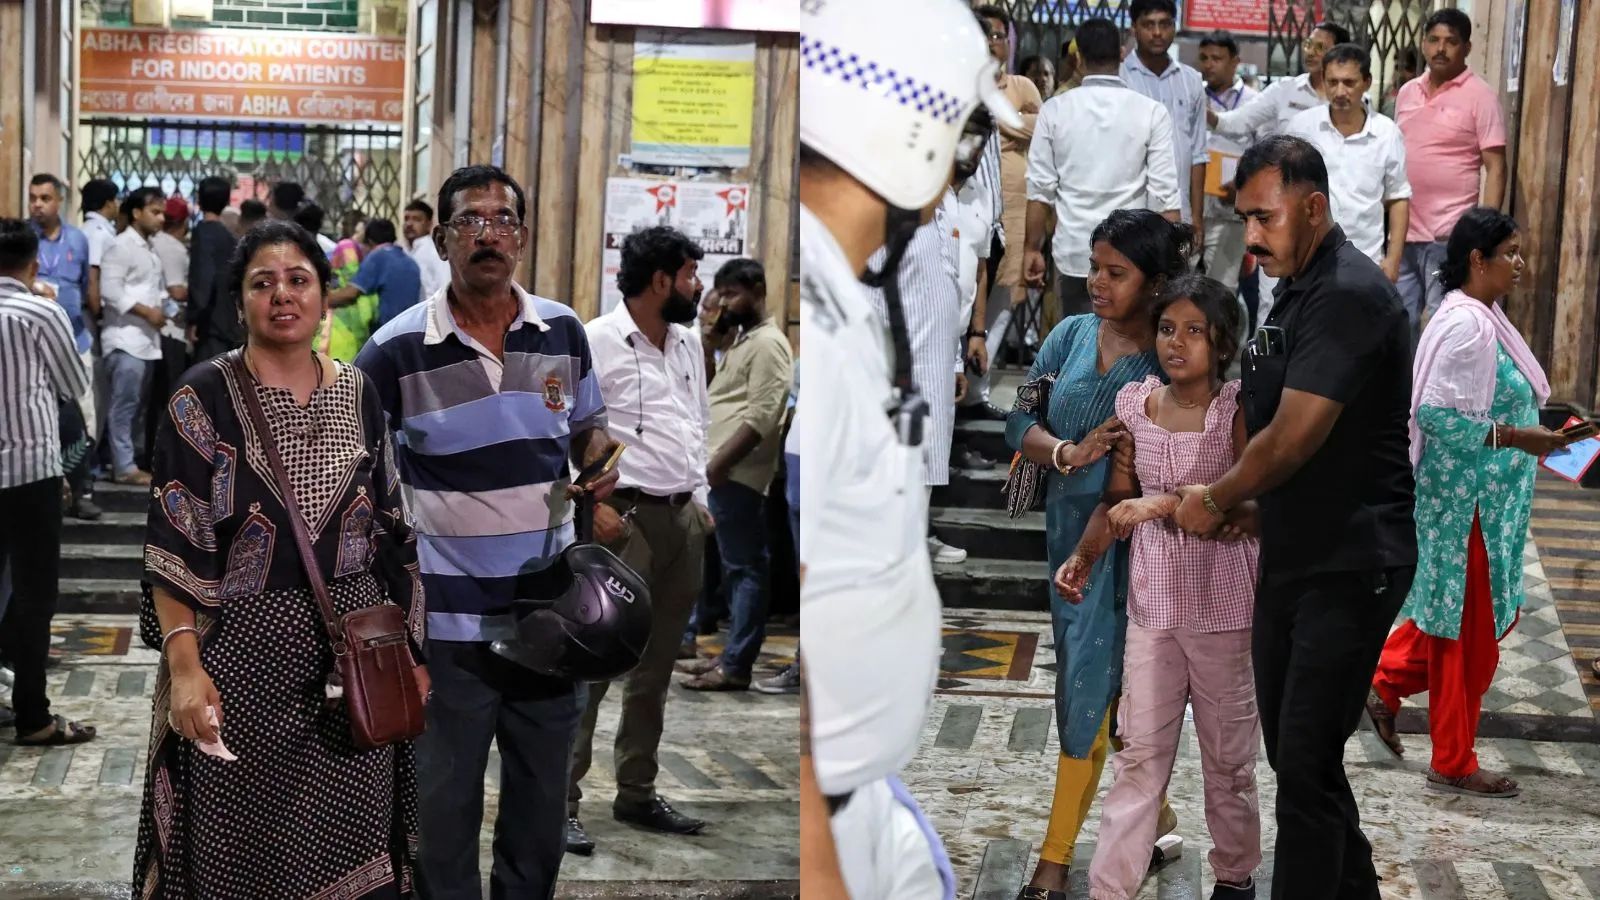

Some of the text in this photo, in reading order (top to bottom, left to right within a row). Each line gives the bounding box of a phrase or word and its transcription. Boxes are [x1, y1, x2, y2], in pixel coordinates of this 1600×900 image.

[82, 31, 404, 61] ABHA REGISTRATION COUNTER
[131, 58, 366, 85] FOR INDOOR PATIENTS
[133, 85, 195, 112] রোগীদের
[202, 94, 235, 112] জন্য
[240, 95, 290, 115] ABHA
